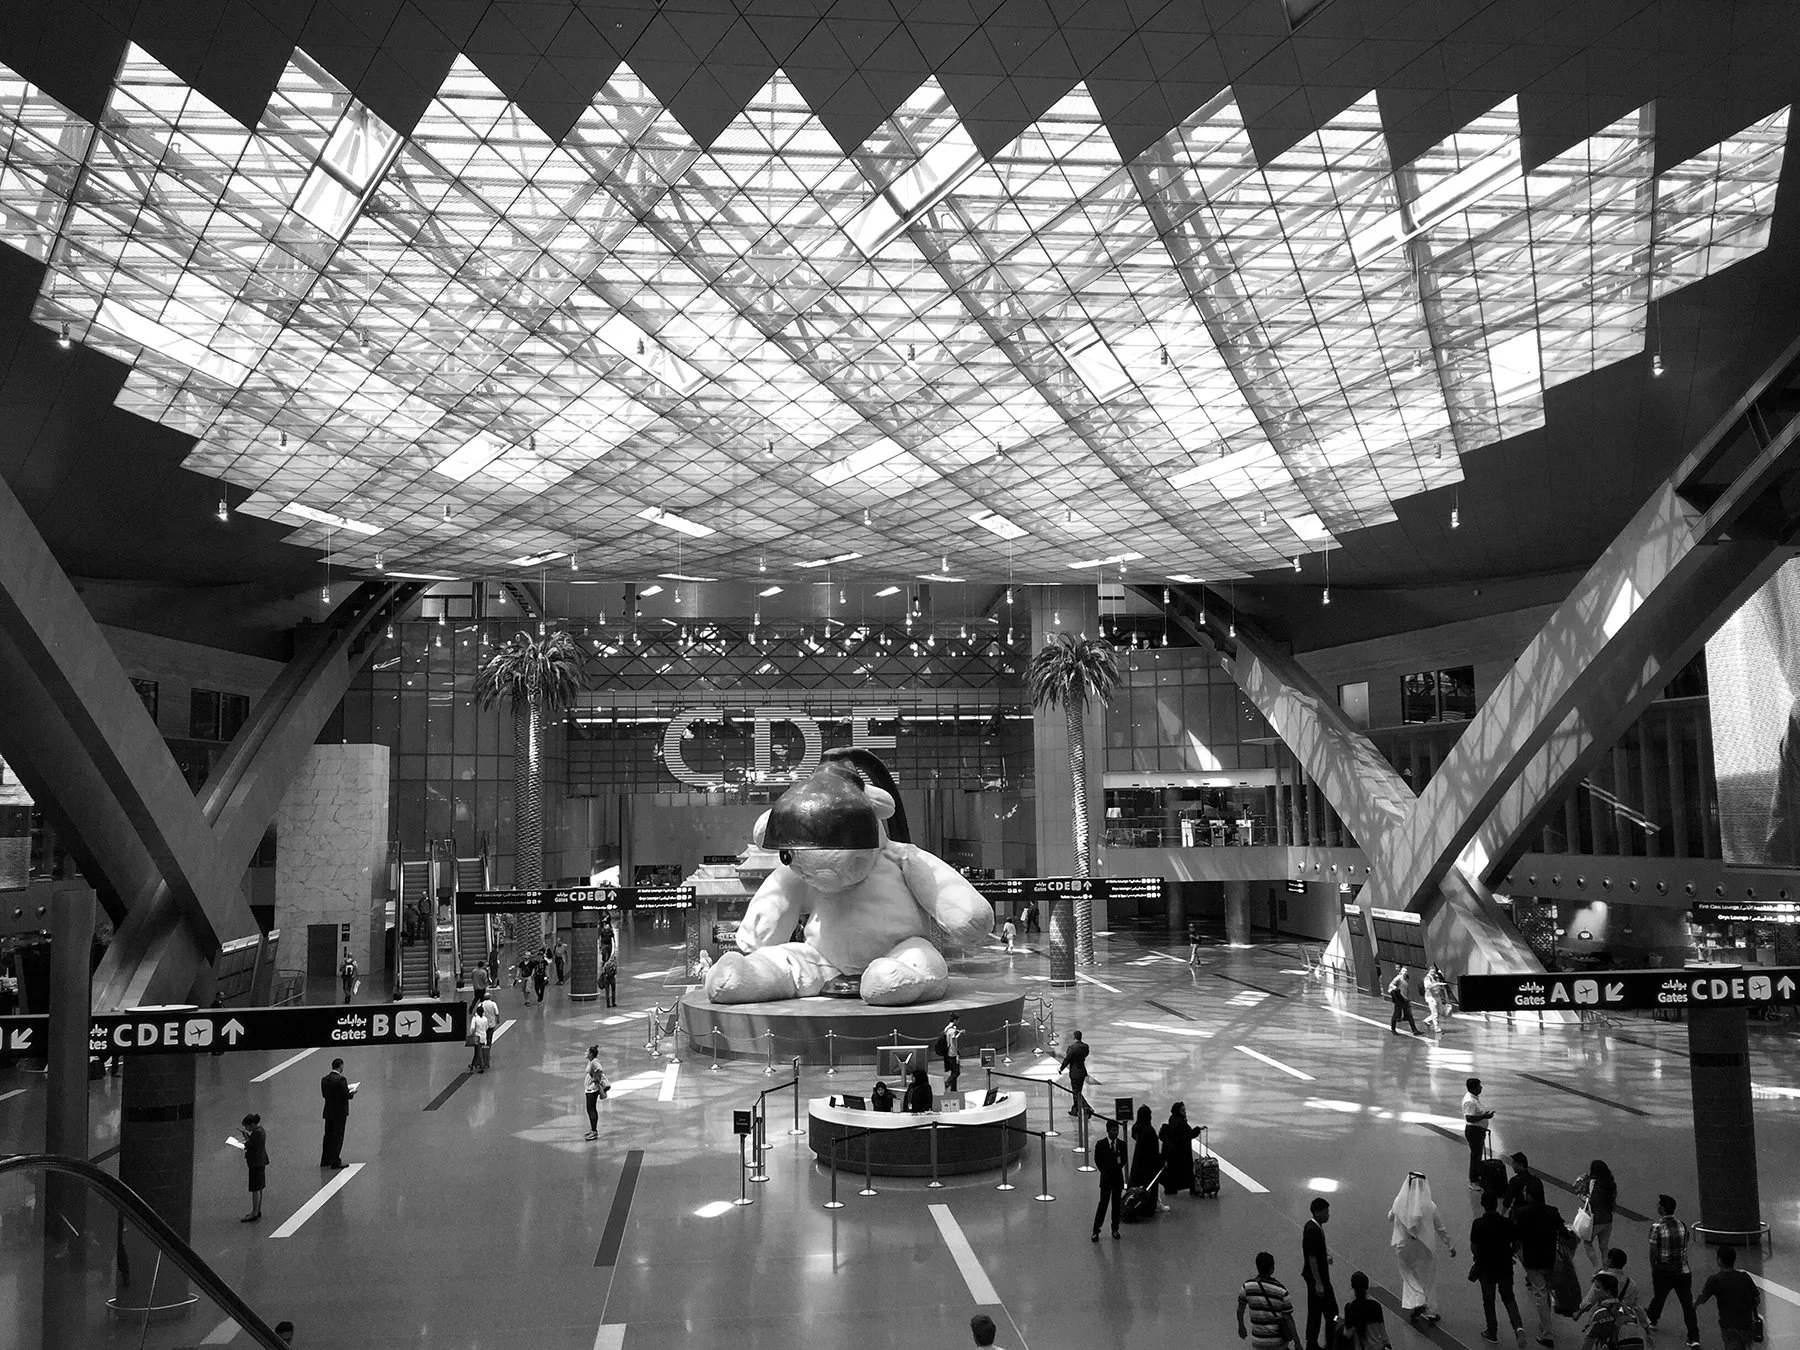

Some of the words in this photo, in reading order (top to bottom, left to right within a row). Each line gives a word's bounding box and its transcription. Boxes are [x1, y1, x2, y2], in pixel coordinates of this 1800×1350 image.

[1514, 995, 1546, 1006] Gates
[1550, 982, 1570, 1003] A
[1658, 992, 1688, 1003] Gates
[331, 1029, 367, 1040] Gates
[373, 1014, 389, 1036] B
[337, 1014, 367, 1027] بوابات
[89, 1039, 108, 1050] tes
